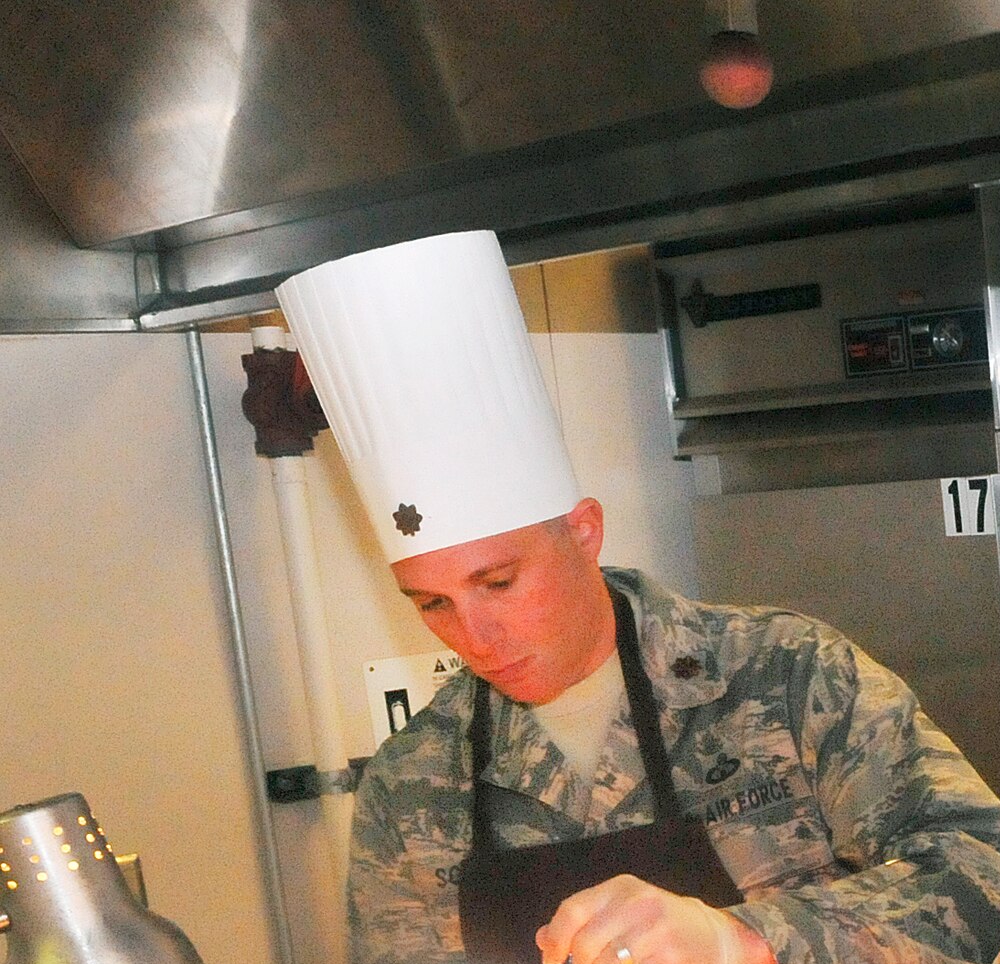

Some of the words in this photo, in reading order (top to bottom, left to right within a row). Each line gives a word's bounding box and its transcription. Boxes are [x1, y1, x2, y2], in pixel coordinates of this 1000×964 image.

[948, 479, 988, 533] 17
[706, 797, 731, 825] AIR
[736, 779, 795, 812] FORCE
